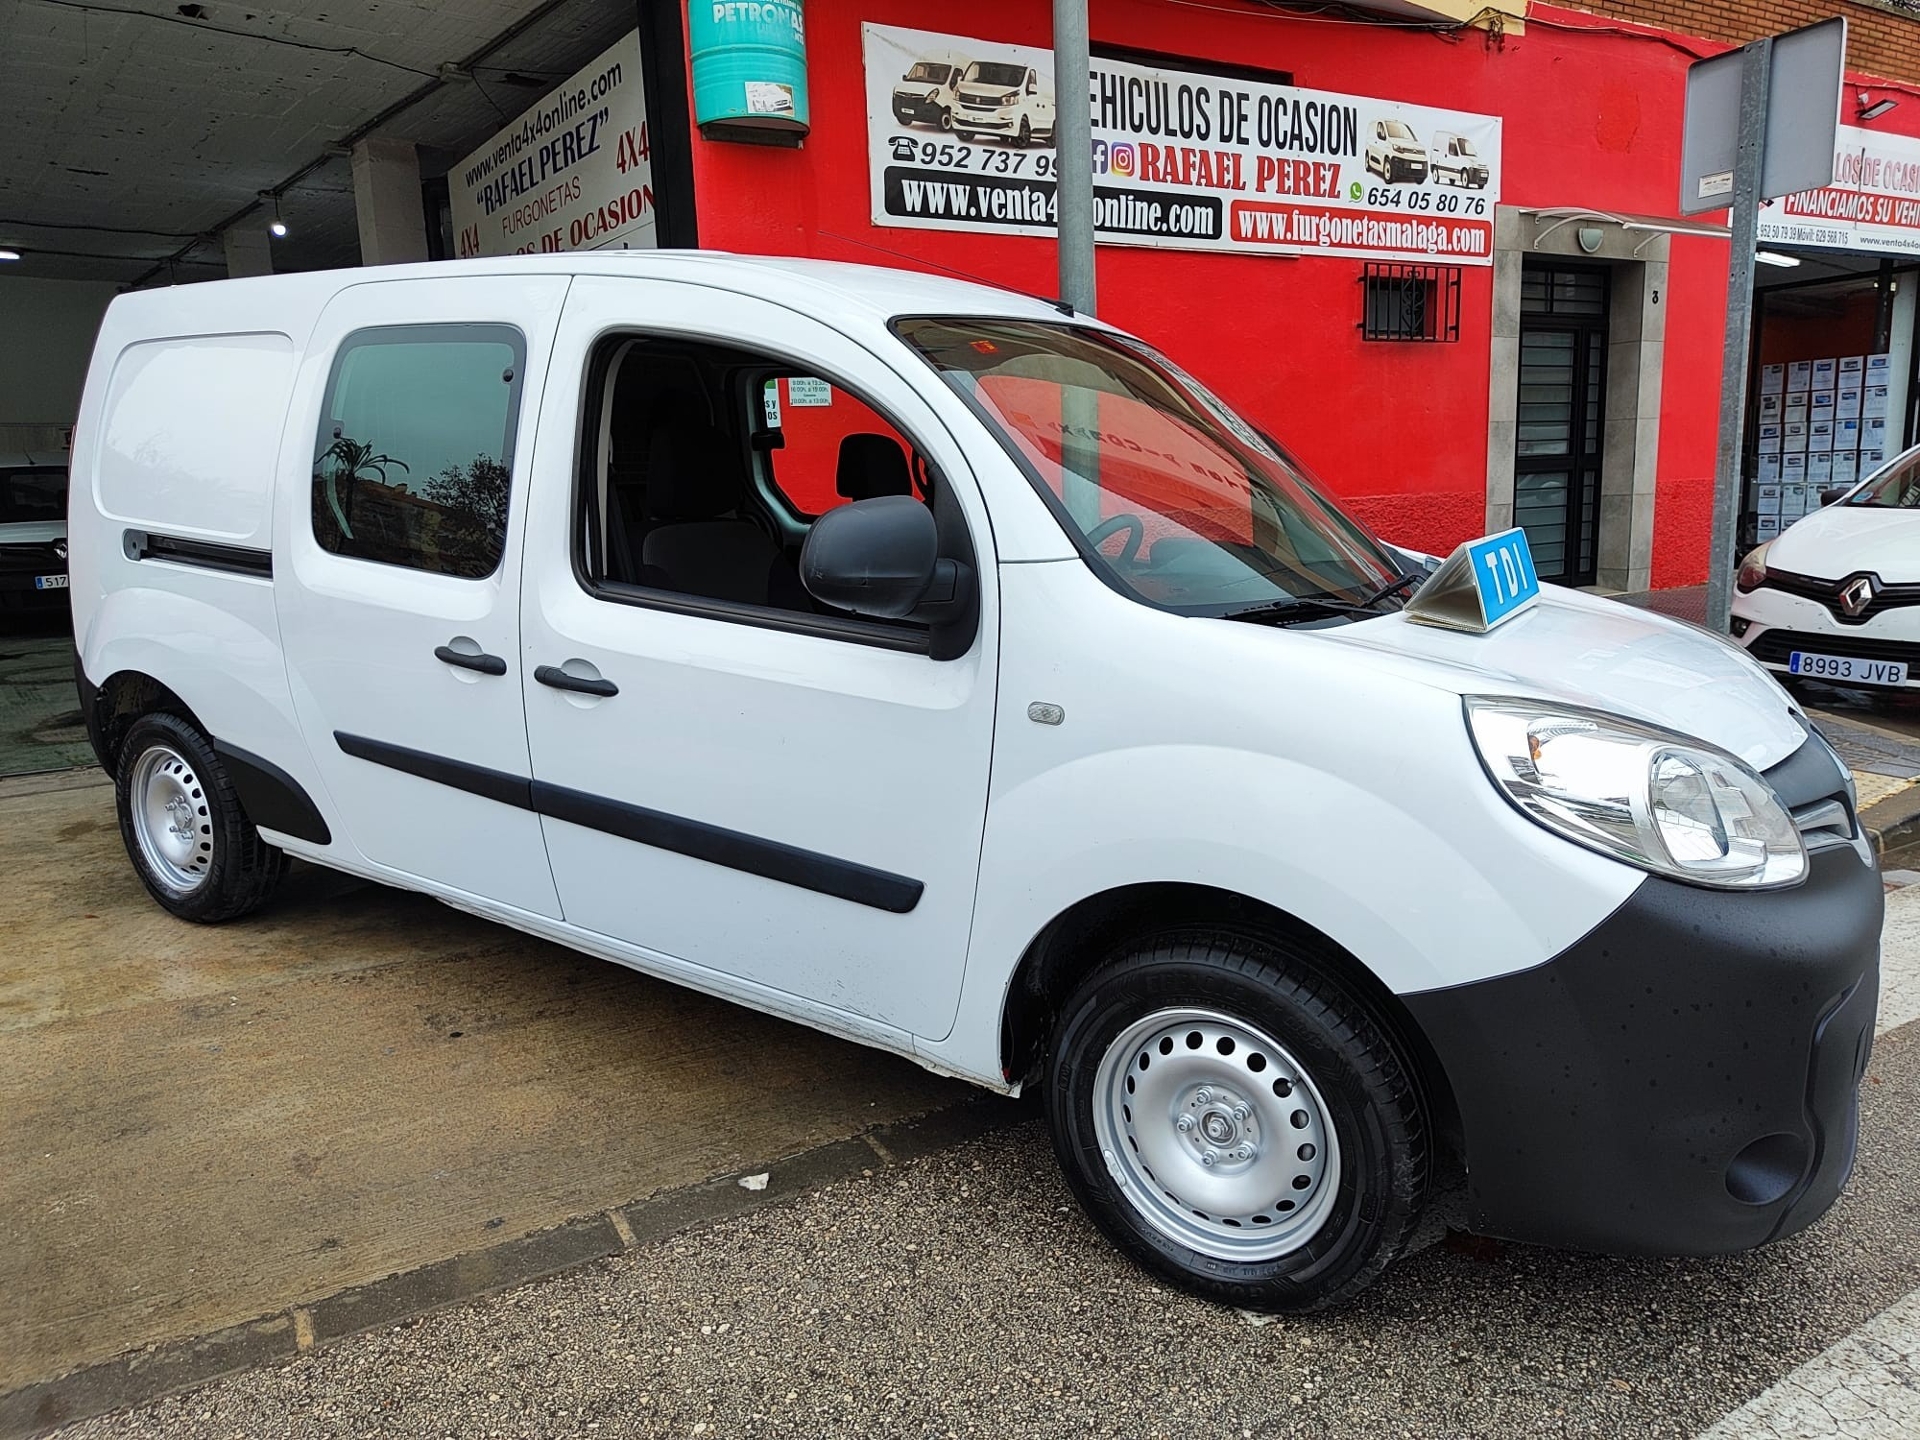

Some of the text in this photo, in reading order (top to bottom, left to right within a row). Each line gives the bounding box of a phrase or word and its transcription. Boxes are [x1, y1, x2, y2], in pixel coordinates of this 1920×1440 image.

[465, 62, 622, 188] www.venta4x4online.com
[1089, 70, 1357, 157] EHICULOS DE OCASION
[920, 142, 972, 169] 952
[980, 148, 1028, 175] 737
[1137, 142, 1341, 199] RAFAEL PEREZ
[1862, 156, 1882, 188] DE
[501, 175, 582, 239] FURGONETAS
[541, 184, 656, 253] DE OCASION
[1367, 187, 1486, 216] 654 05 80 76
[1785, 189, 1873, 221] FINANCIAMOS
[1875, 197, 1893, 223] SU
[460, 223, 480, 259] 4X4
[1238, 208, 1485, 254] www.furgonetasmalaga.com
[1652, 290, 1659, 305] 3
[45, 576, 67, 588] 517
[1484, 542, 1528, 605] TDI
[1802, 656, 1901, 683] 8993 JVB
